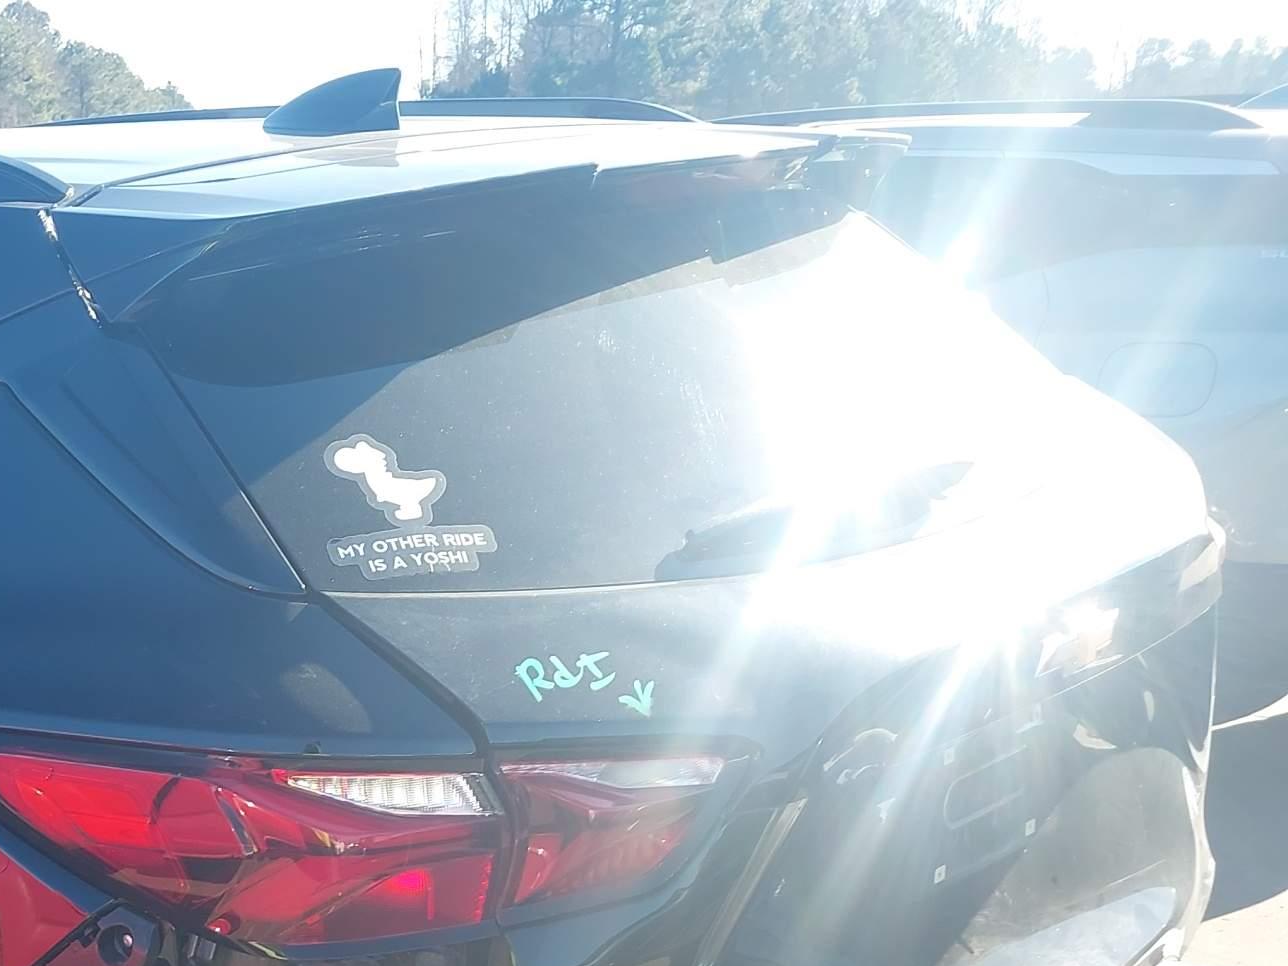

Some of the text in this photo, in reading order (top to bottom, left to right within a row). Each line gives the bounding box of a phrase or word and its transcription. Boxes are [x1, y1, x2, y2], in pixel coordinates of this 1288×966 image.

[336, 532, 487, 559] MY OTHER RIDE
[368, 551, 469, 572] IS A YOSHI
